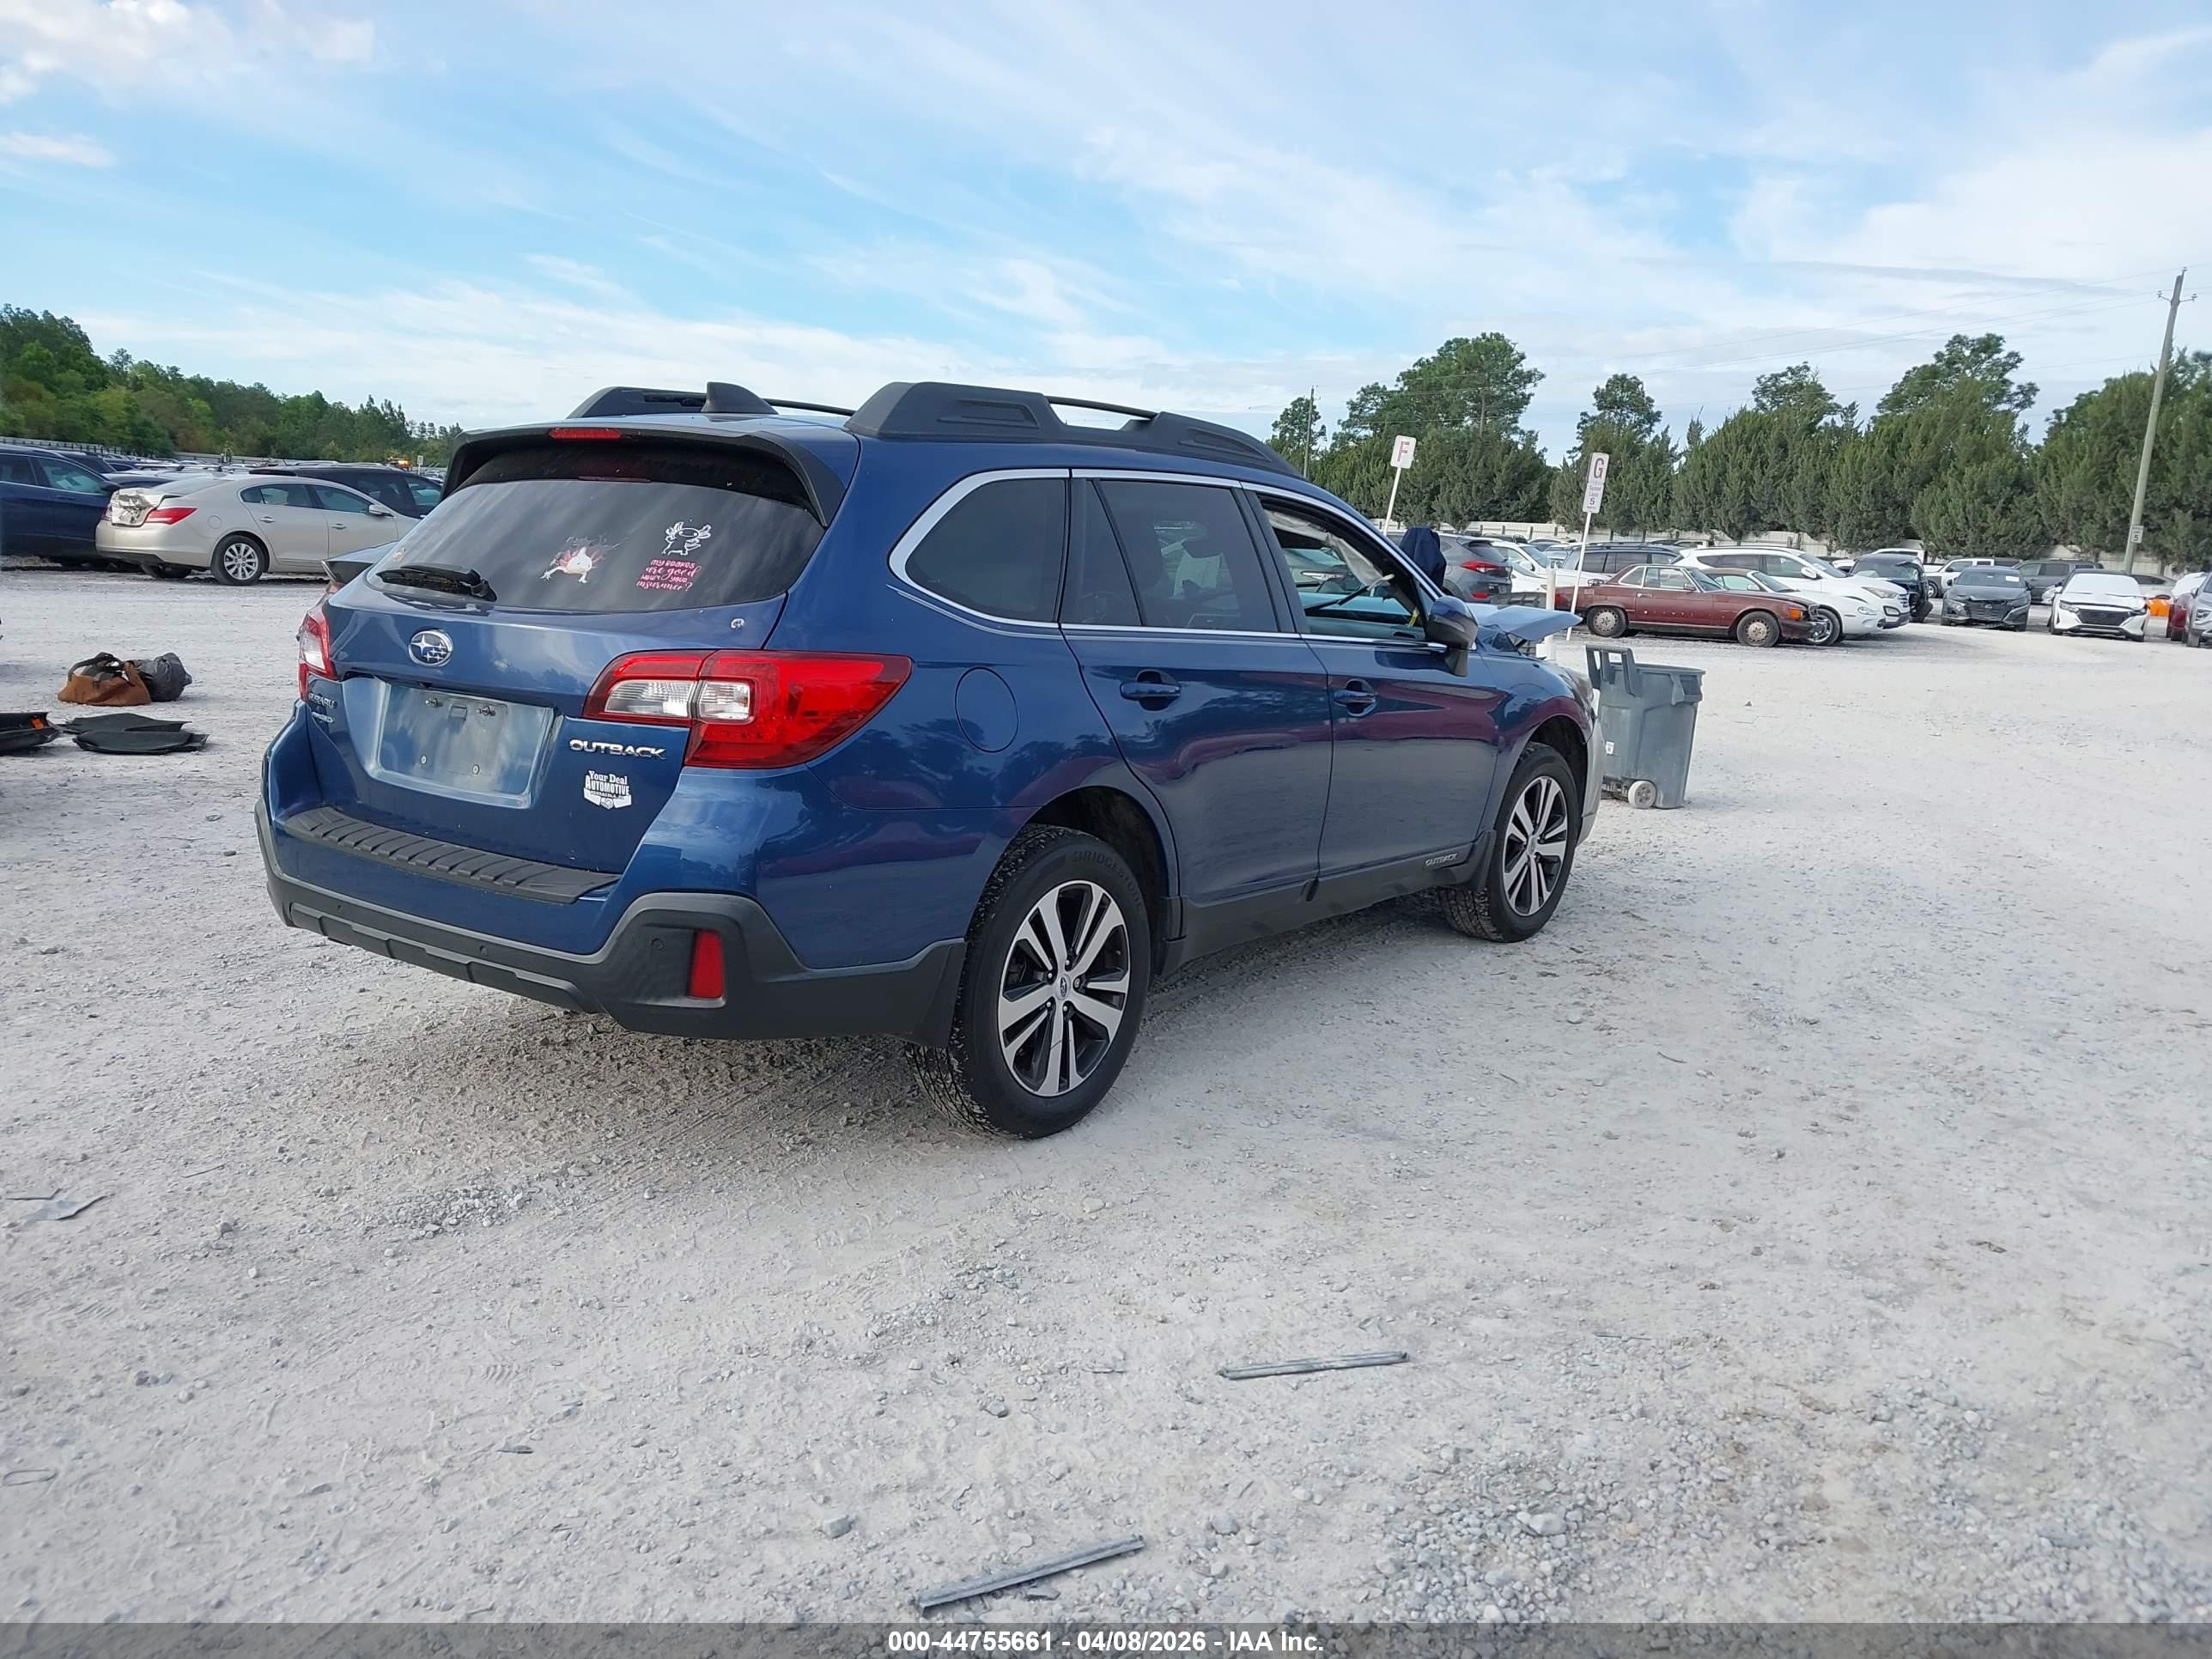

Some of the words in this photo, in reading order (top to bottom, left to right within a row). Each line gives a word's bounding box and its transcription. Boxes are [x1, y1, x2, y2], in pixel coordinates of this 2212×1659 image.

[1397, 441, 1410, 462] F
[1594, 457, 1605, 479] G
[569, 739, 666, 760] OUTBACK
[585, 775, 630, 796] AUTOMOTIVE
[588, 769, 609, 782] Your
[609, 773, 628, 785] Deal
[1425, 852, 1458, 866] OUTBACK
